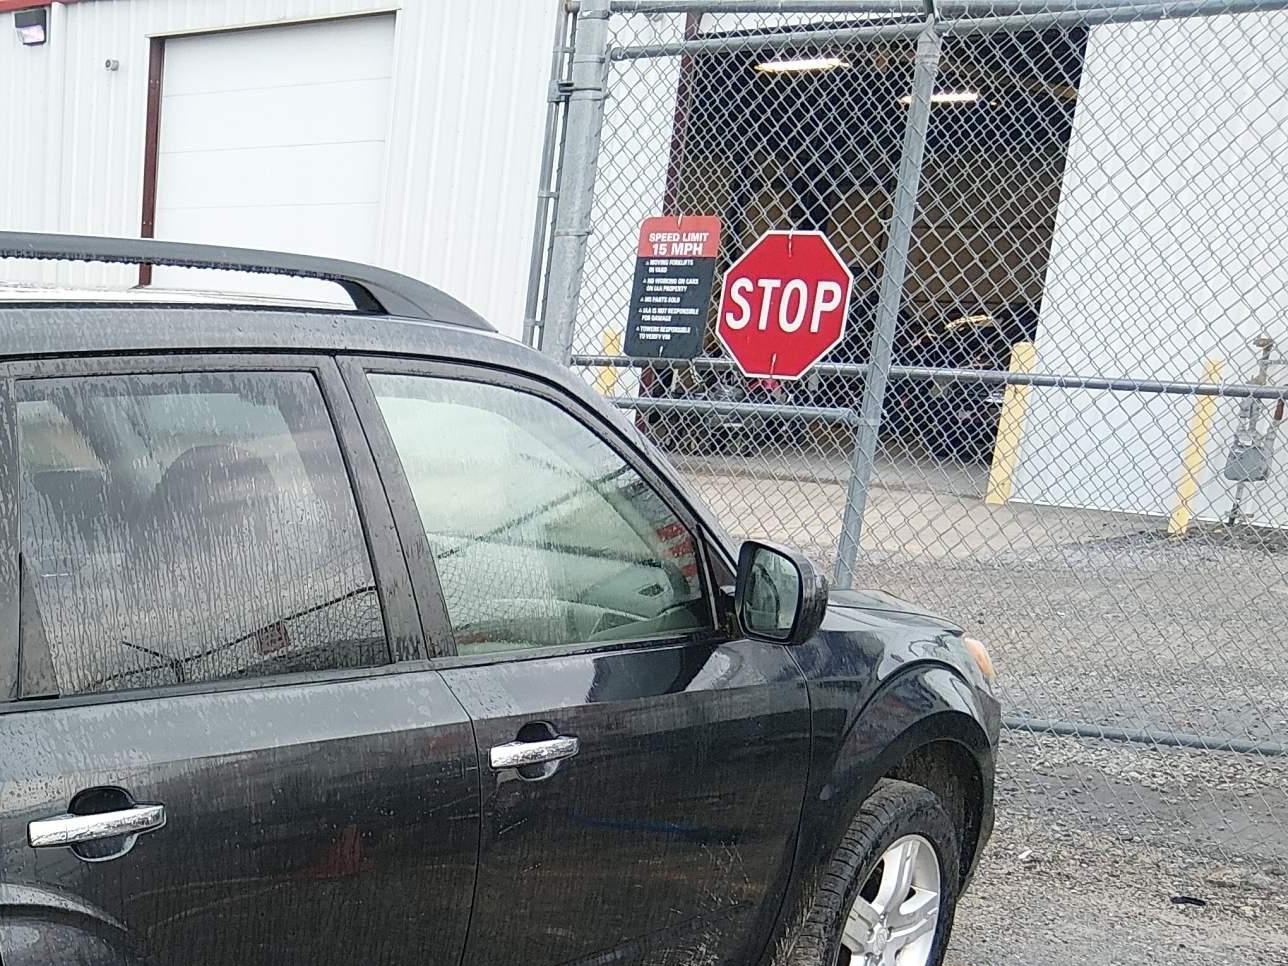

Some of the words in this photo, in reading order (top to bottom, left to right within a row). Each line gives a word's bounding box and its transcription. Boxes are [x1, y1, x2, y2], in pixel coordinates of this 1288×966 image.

[649, 232, 680, 242] SPEED
[682, 232, 709, 242] LIMIT
[652, 243, 668, 256] 15
[670, 243, 703, 256] MPH
[725, 276, 842, 334] STOP
